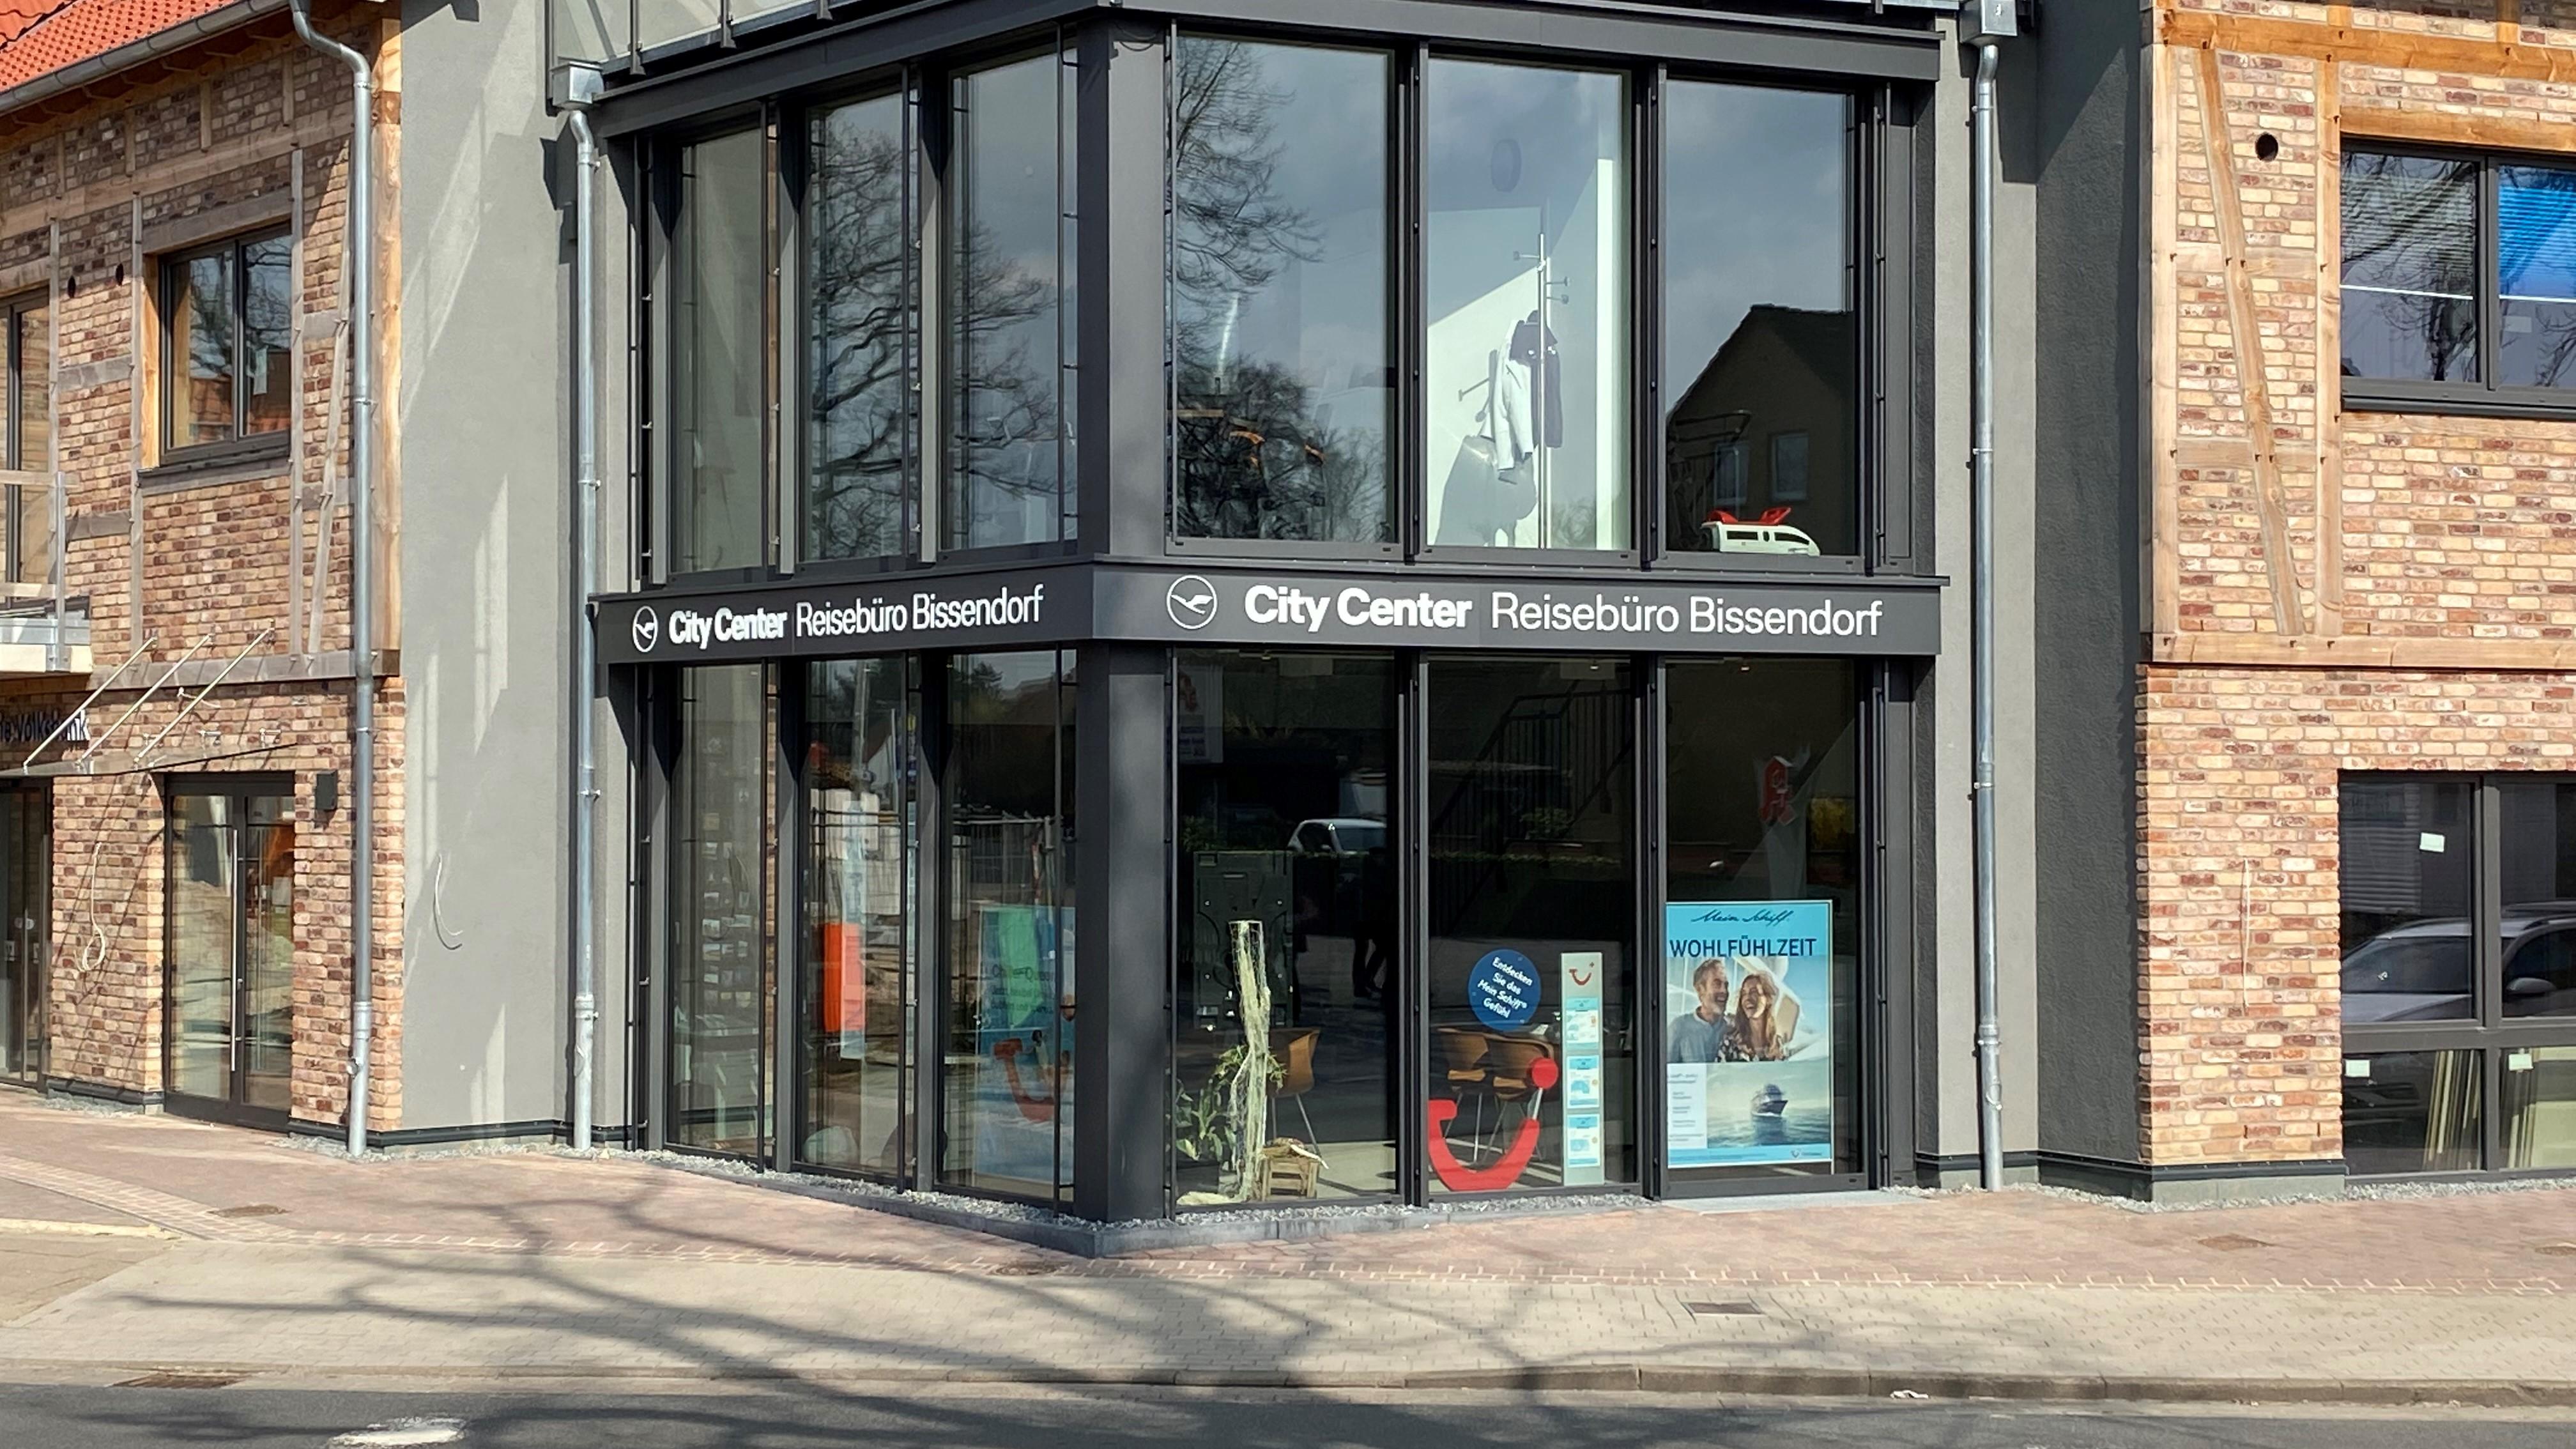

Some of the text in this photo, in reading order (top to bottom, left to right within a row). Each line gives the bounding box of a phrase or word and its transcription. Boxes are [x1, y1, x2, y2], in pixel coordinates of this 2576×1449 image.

[669, 583, 1045, 650] City Center Reisebüro Bissendorf
[1244, 584, 1883, 636] City Center Reisebüro Bissendorf
[1691, 909, 1739, 922] Mein
[1669, 935, 1817, 958] WOHLFÜHLZEIT
[1492, 957, 1533, 986] Entdecken
[1477, 979, 1497, 996] Mein
[1492, 972, 1521, 995] Sie das
[1483, 997, 1511, 1018] Gefühl
